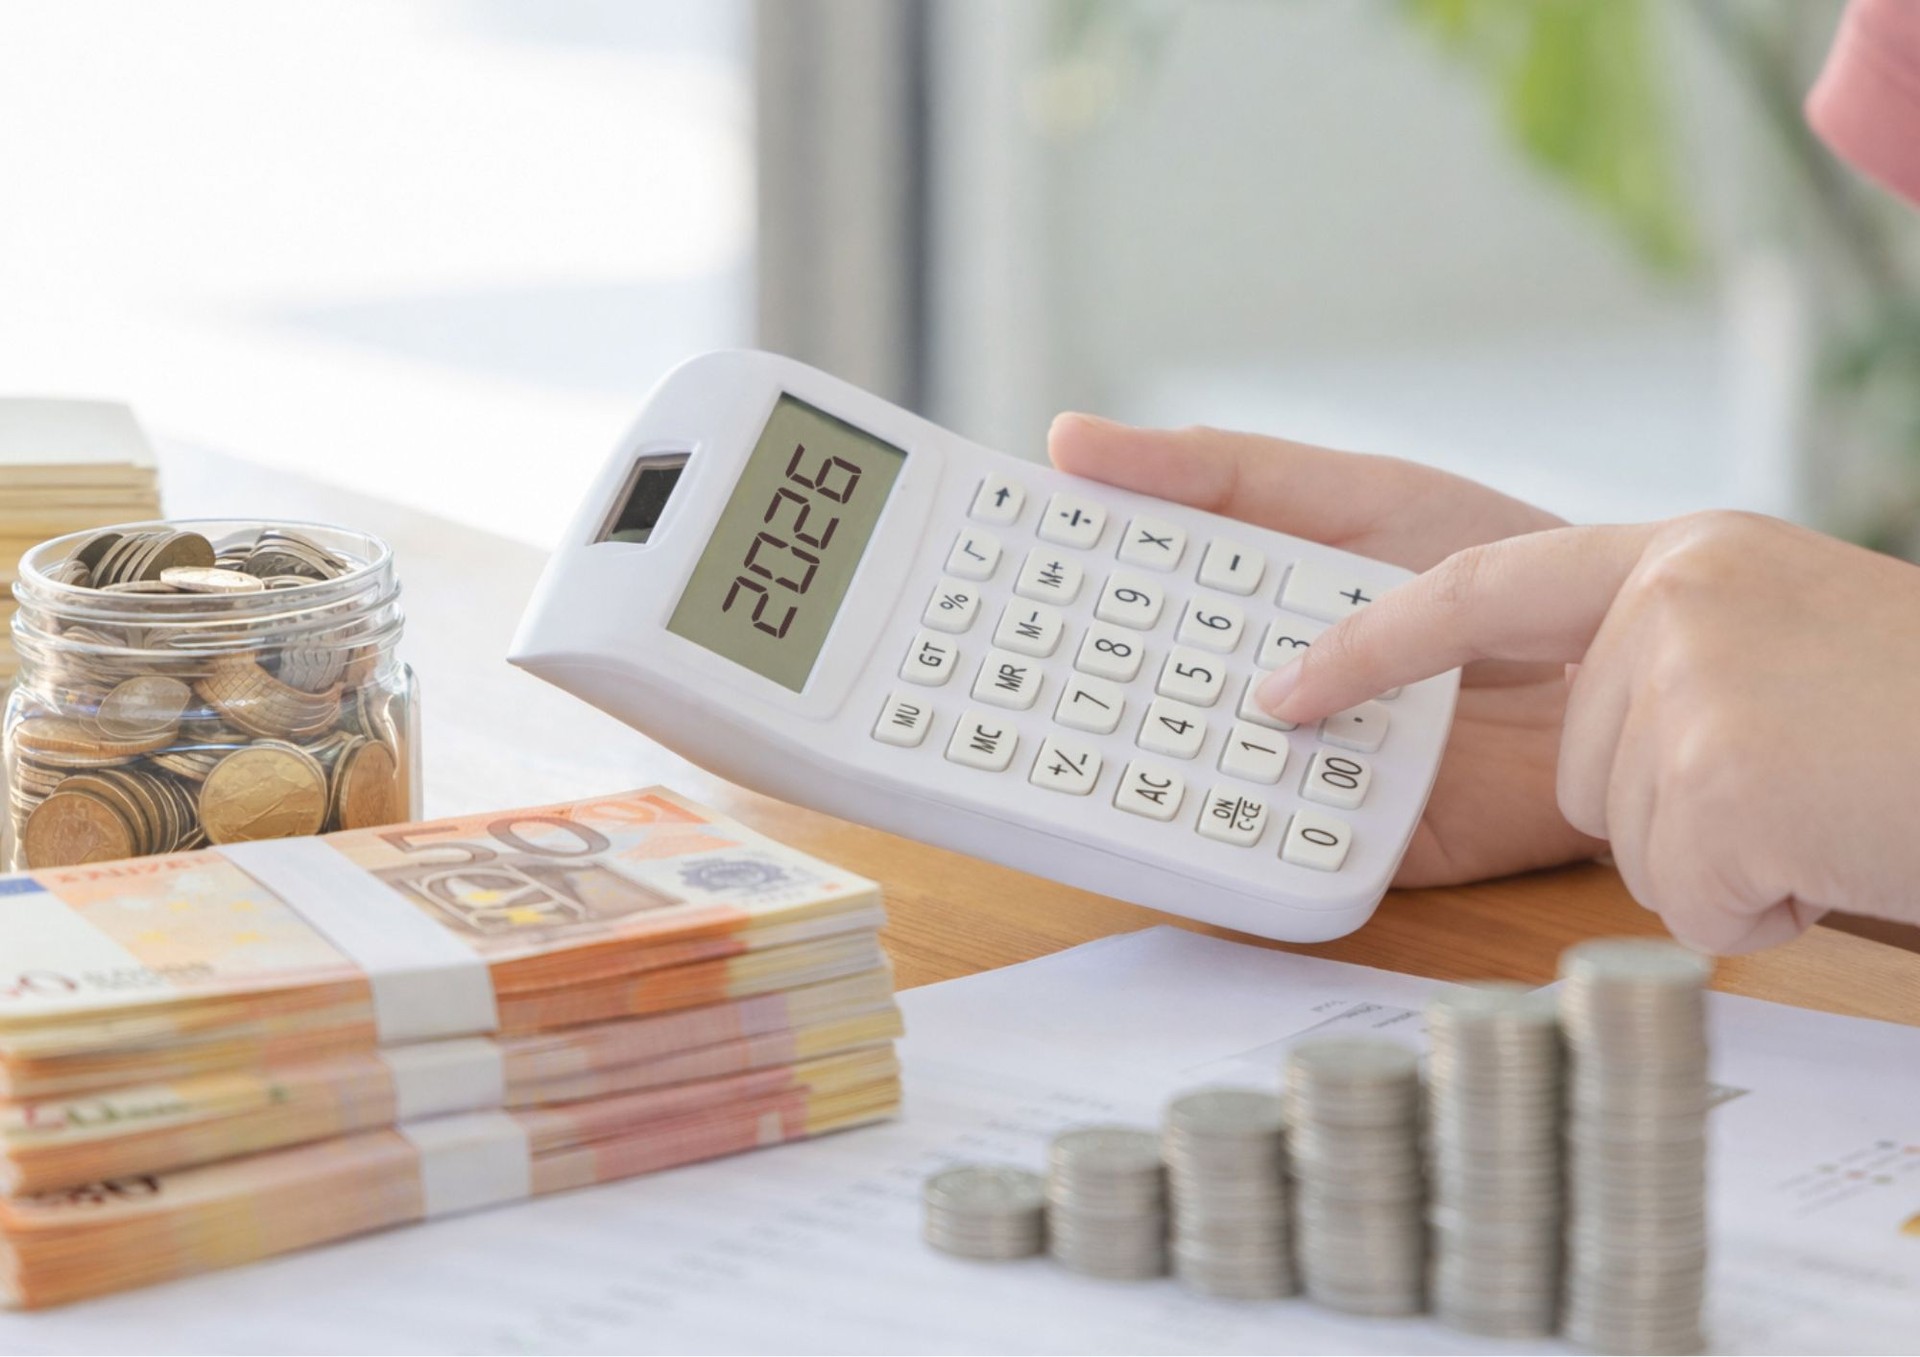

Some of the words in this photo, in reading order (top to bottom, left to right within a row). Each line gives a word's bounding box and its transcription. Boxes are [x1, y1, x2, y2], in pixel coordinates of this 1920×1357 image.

[722, 443, 863, 639] 2026
[1037, 561, 1064, 588] M+
[939, 594, 969, 610] %
[1115, 588, 1151, 607] 9
[1015, 611, 1043, 639] M-
[1196, 611, 1232, 630] 6
[1095, 638, 1132, 657] 8
[1276, 636, 1311, 648] 3
[918, 641, 946, 667] GT
[994, 664, 1027, 692] MR
[1175, 662, 1212, 683] 5
[1073, 690, 1110, 710] 7
[892, 703, 920, 728] MU
[1159, 716, 1194, 735] 4
[970, 724, 1003, 754] MC
[1240, 741, 1277, 755] 1
[1321, 757, 1362, 789] 00
[1135, 772, 1172, 805] AC
[1212, 798, 1234, 819] ON
[377, 815, 610, 867] 50
[1301, 828, 1338, 846] 0
